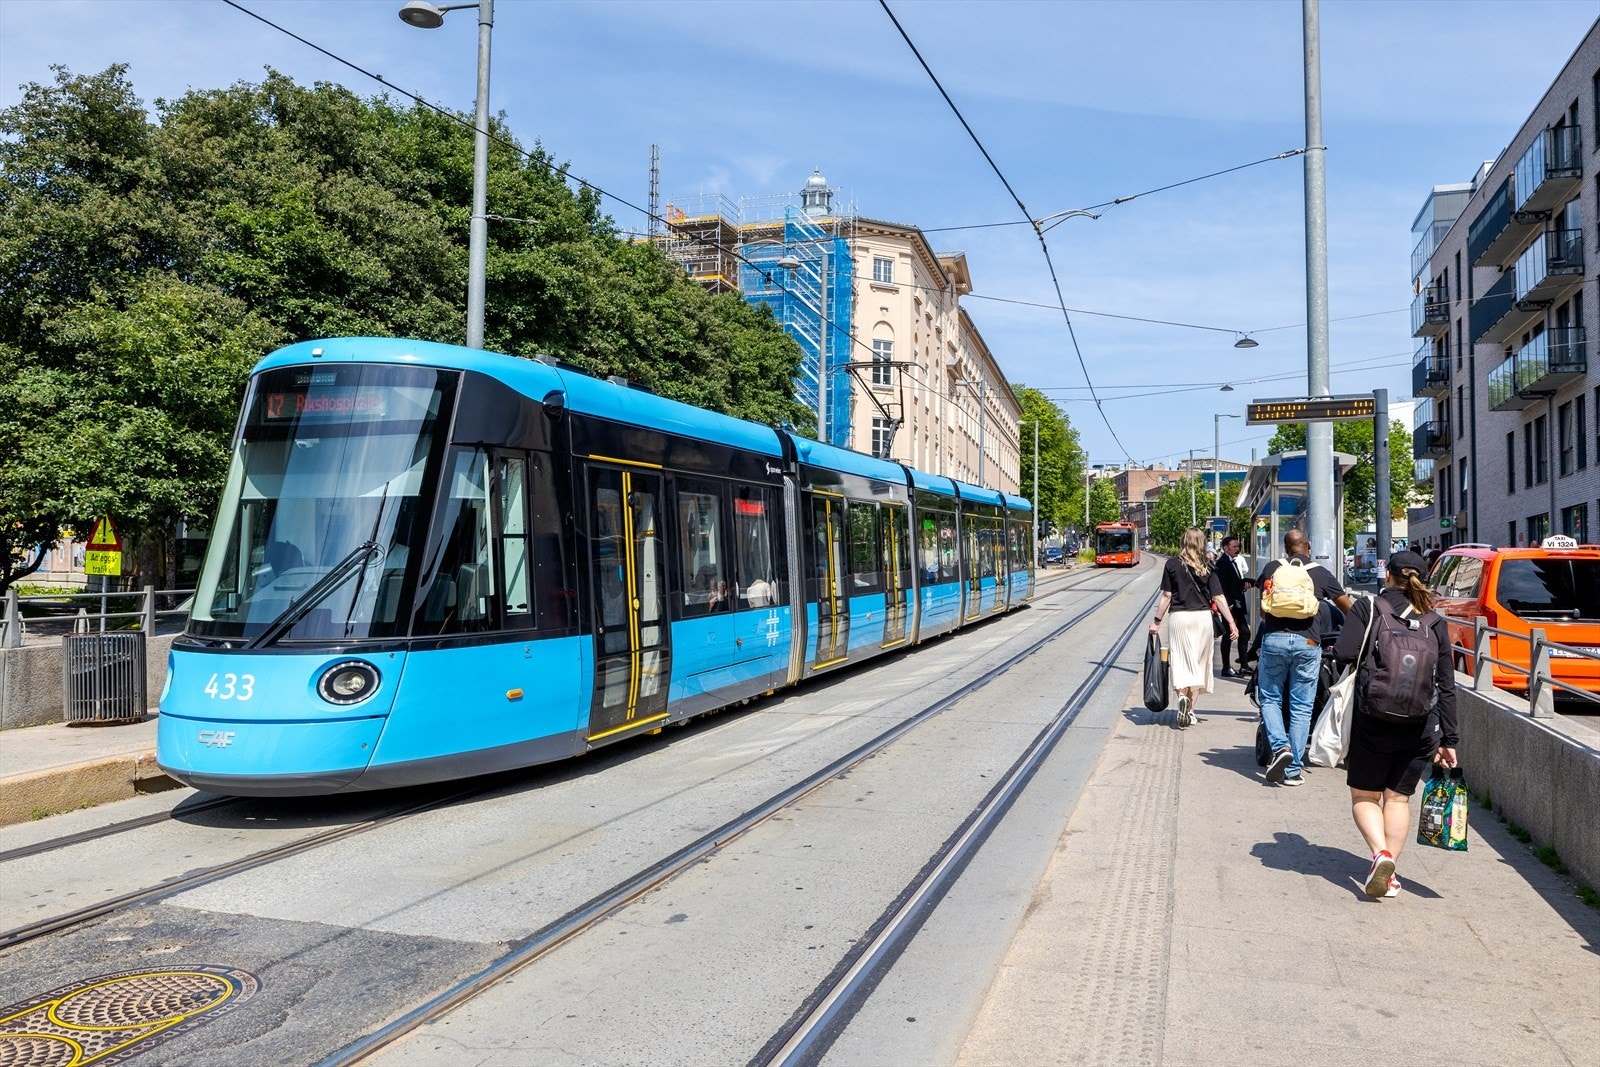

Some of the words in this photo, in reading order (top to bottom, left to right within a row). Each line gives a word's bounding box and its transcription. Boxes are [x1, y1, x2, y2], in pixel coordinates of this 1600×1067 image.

[267, 394, 284, 416] 17
[91, 553, 116, 564] Aneggs-
[204, 673, 256, 701] 433
[198, 729, 236, 749] CAF
